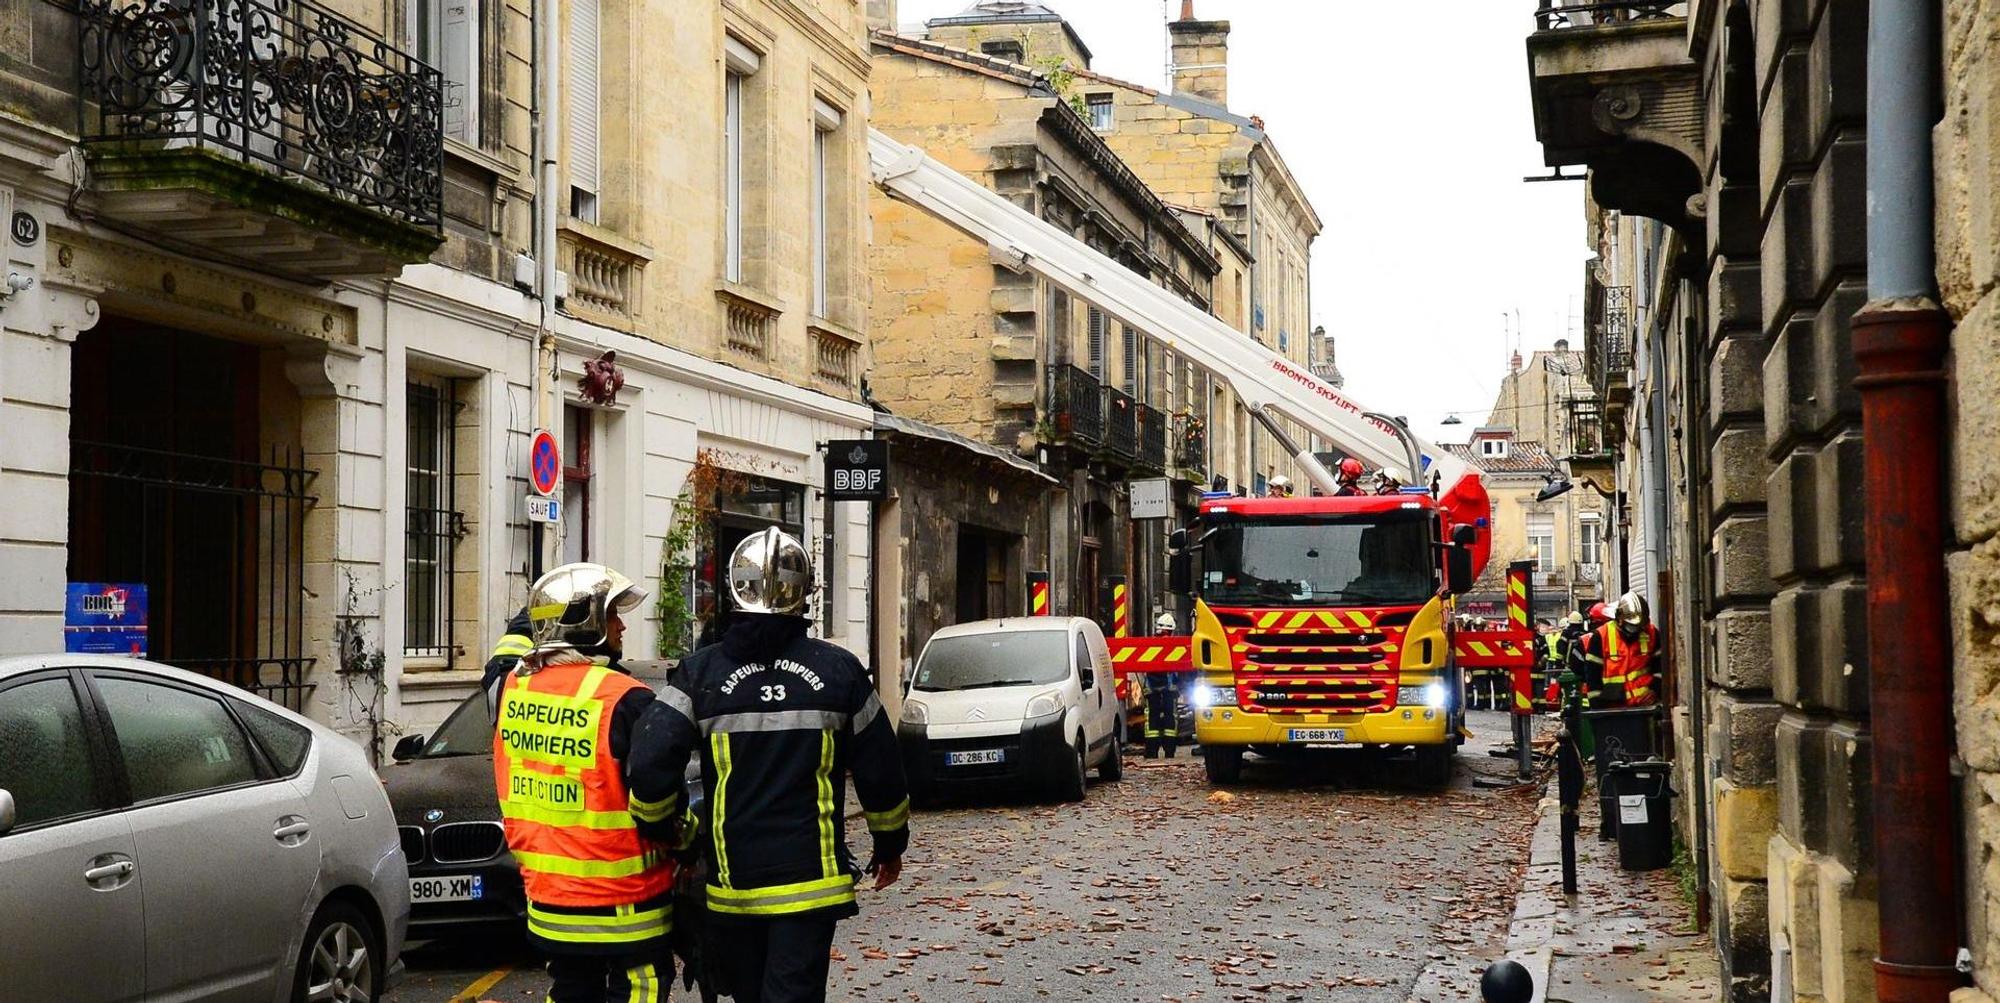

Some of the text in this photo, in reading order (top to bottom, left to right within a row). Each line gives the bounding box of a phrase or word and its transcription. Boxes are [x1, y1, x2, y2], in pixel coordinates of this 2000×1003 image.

[17, 217, 34, 239] 62
[1272, 360, 1317, 391] BRONTO
[1315, 386, 1359, 415] SKYLIFT
[834, 469, 881, 490] BBF
[530, 502, 548, 515] SAUF
[720, 659, 825, 695] SAPEURS POMPIERS
[760, 684, 787, 702] 33
[507, 700, 590, 729] SAPEURS
[501, 728, 592, 758] POMPIERS
[513, 775, 578, 804] DETCTION
